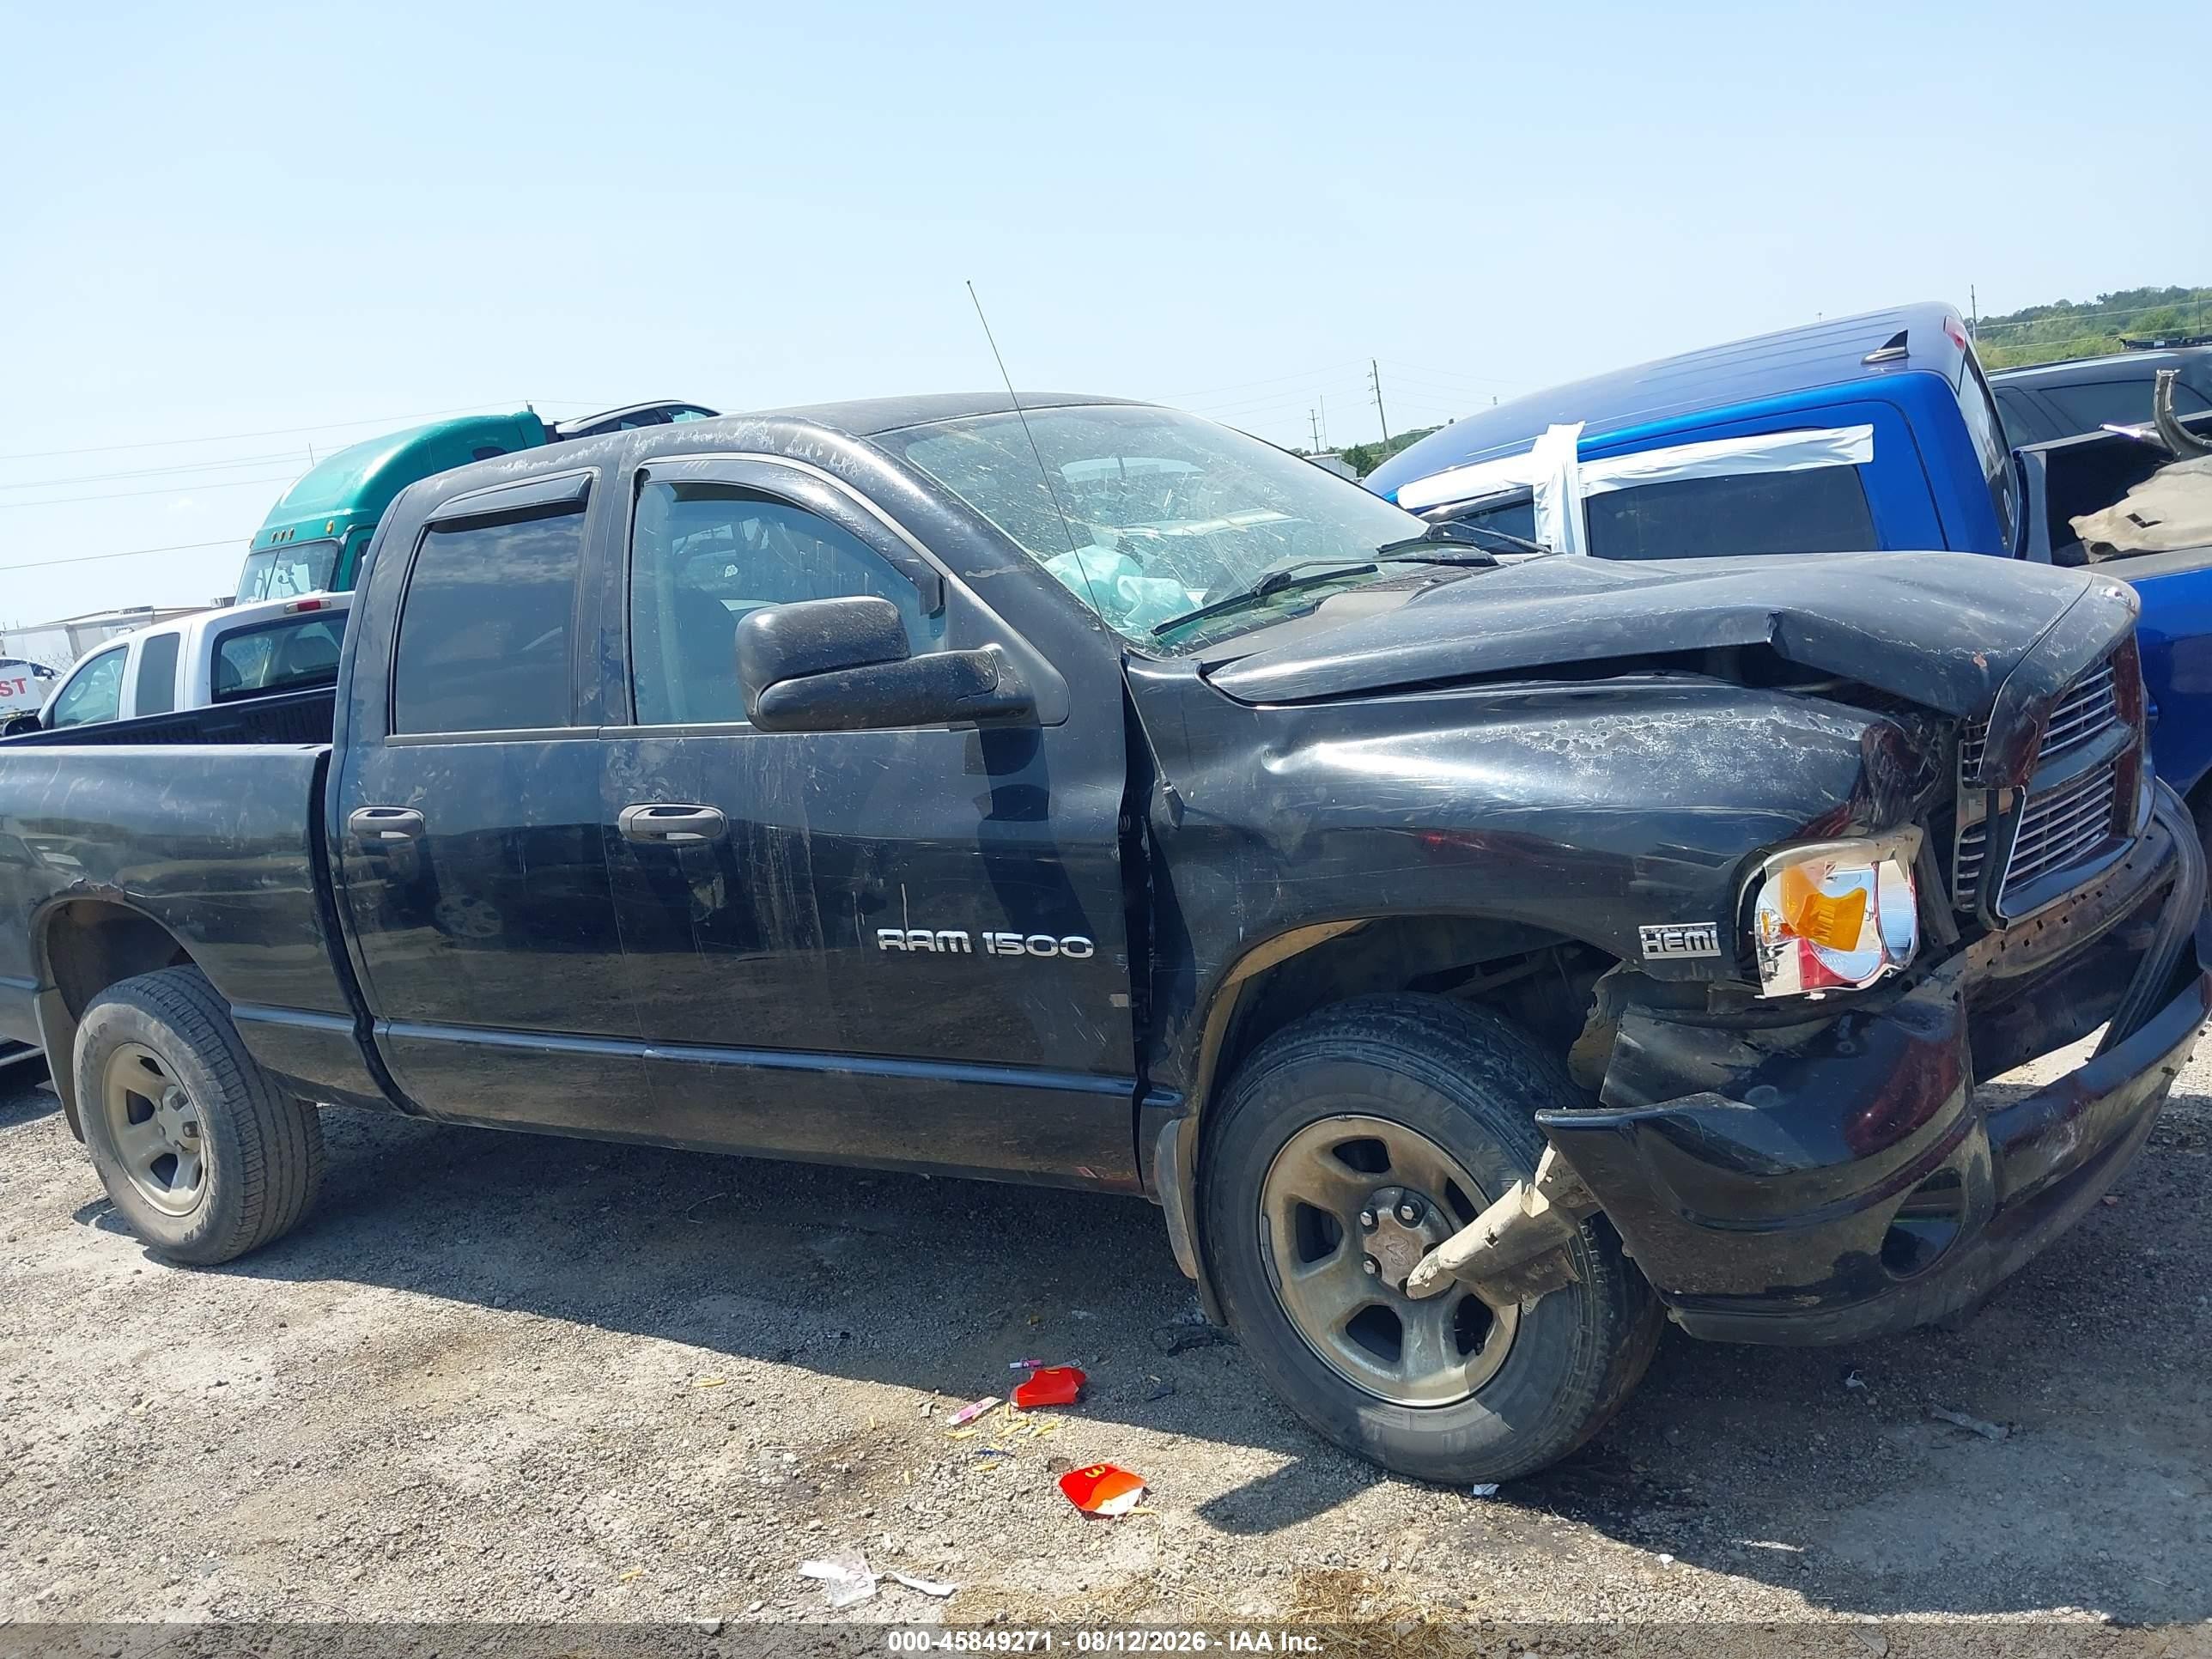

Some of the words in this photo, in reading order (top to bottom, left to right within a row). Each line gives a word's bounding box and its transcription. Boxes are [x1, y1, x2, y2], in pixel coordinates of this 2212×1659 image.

[877, 929, 973, 953] RAM
[981, 932, 1095, 959] 1500
[1640, 931, 1719, 953] HEMI
